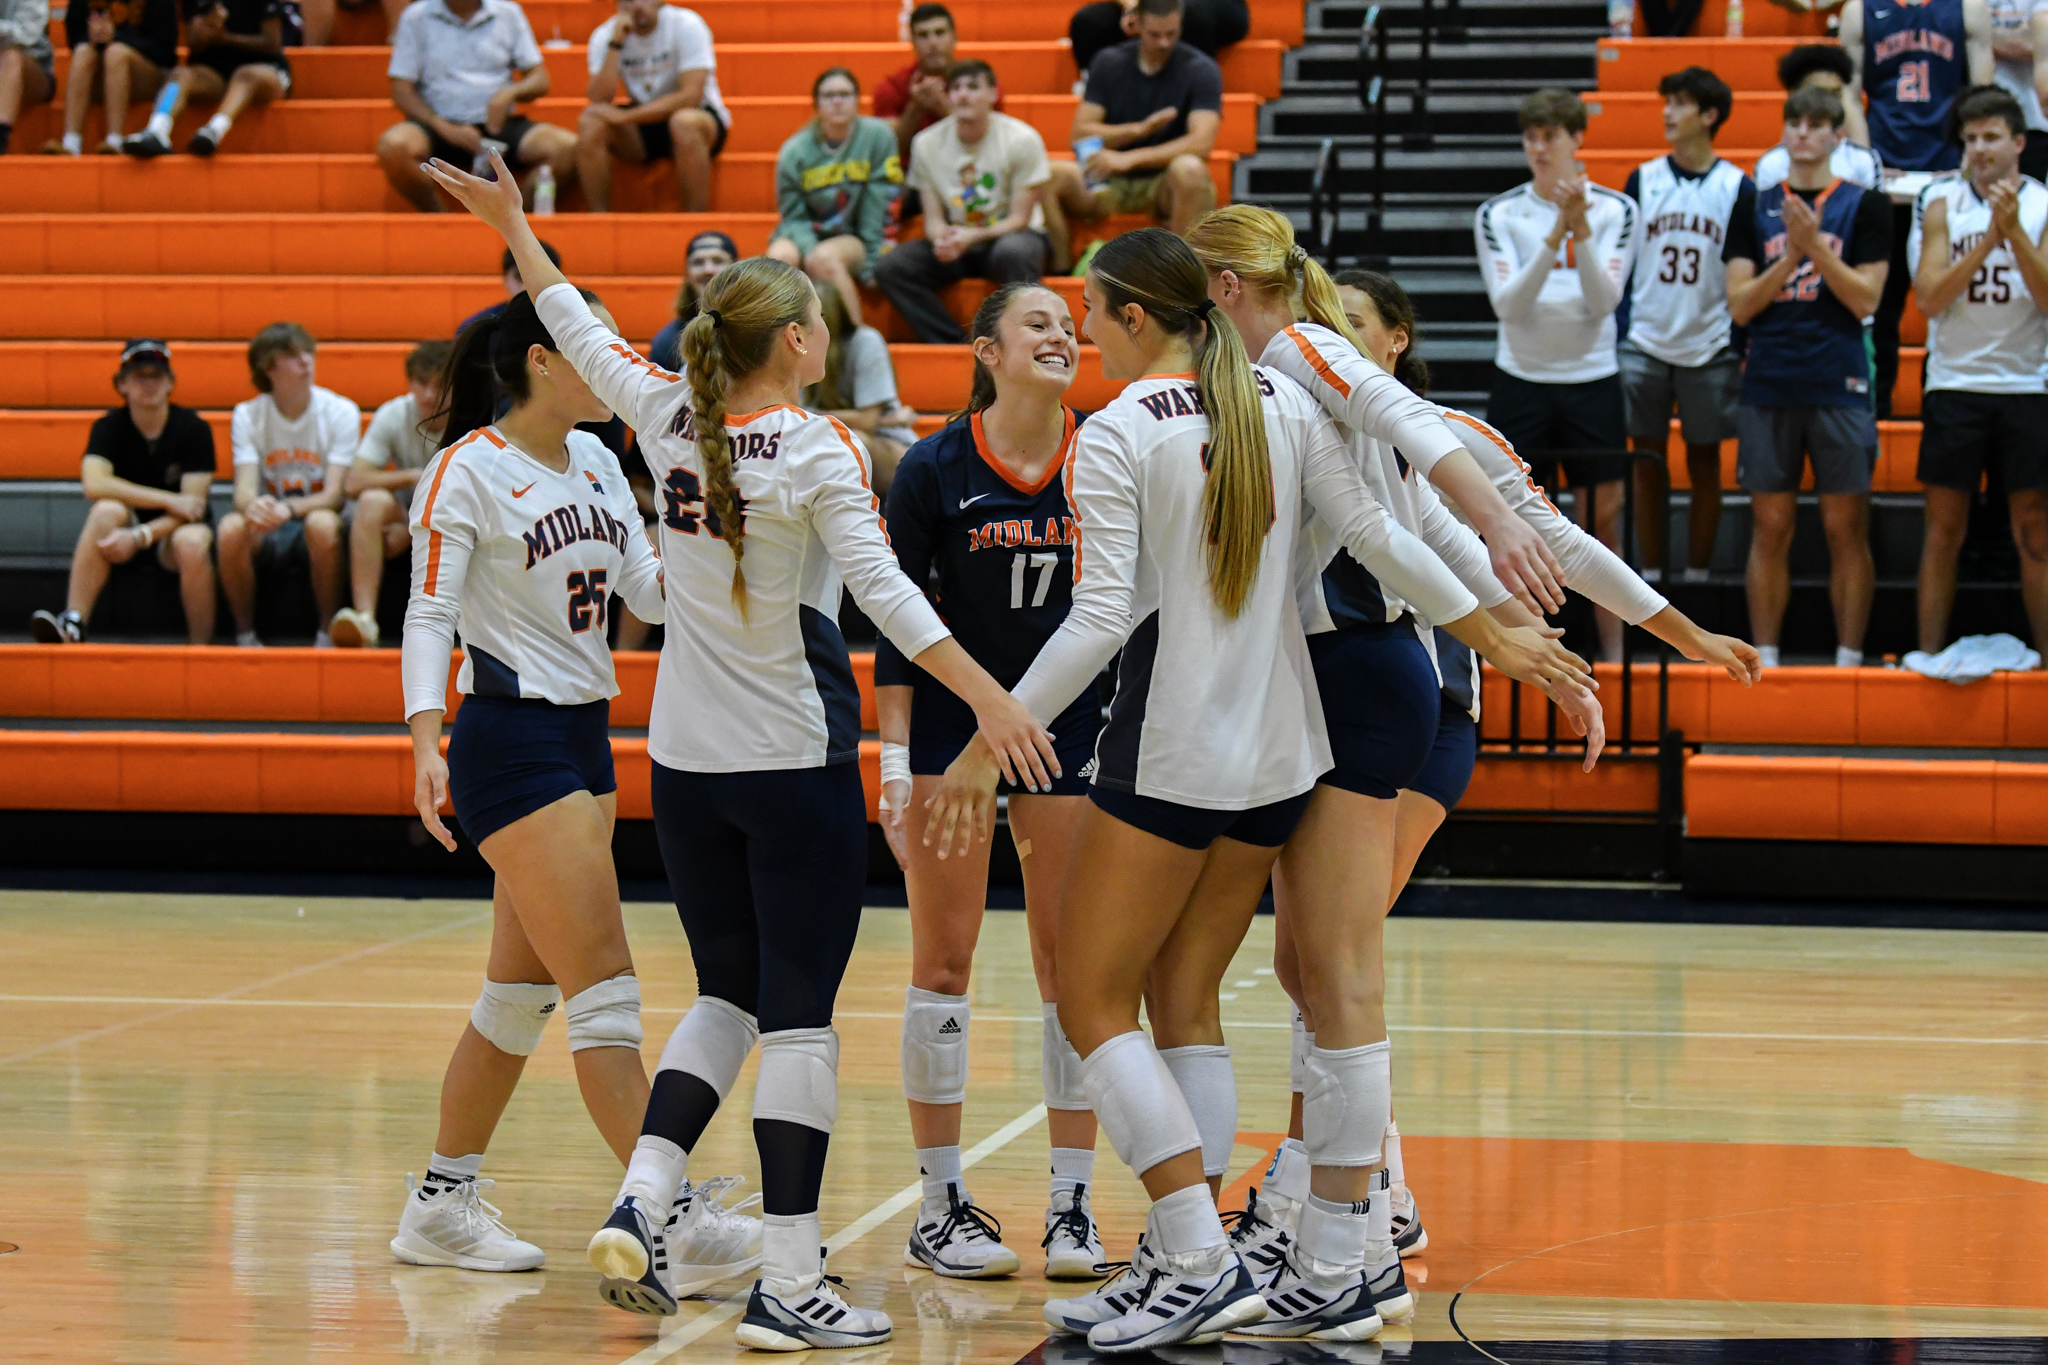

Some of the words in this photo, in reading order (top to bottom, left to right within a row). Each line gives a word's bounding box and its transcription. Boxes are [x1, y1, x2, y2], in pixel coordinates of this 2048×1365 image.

[1875, 29, 1954, 64] MIDLAND
[1897, 60, 1930, 103] 21
[1646, 212, 1722, 245] MIDLAND
[1659, 246, 1701, 285] 33
[1968, 265, 2011, 304] 25
[521, 503, 629, 572] MIDLAND
[968, 516, 1075, 552] MIDLAN
[1010, 551, 1059, 609] 17
[566, 568, 607, 635] 25
